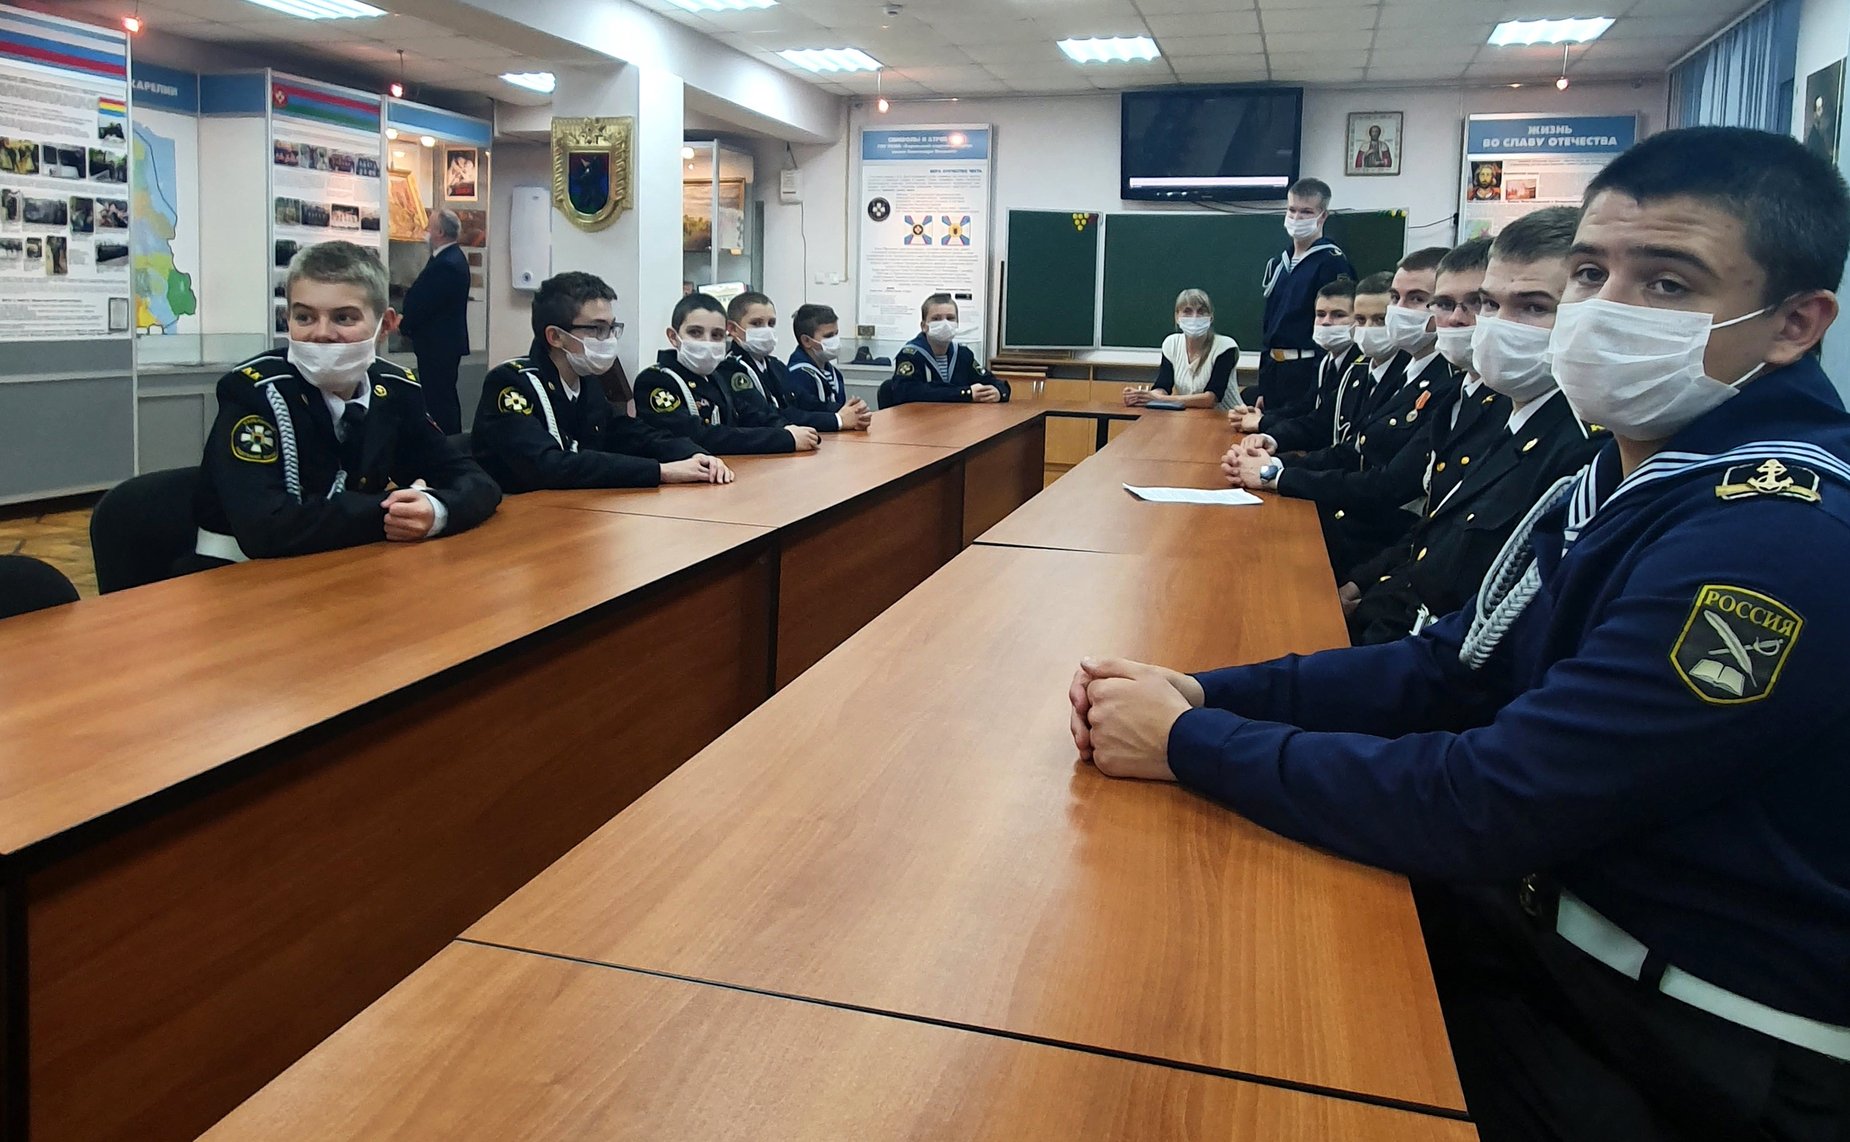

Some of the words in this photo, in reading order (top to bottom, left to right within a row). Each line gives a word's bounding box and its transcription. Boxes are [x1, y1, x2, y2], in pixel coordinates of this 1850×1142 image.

[1528, 125, 1573, 135] ЖИЗНЬ
[1482, 138, 1500, 148] ВО
[1503, 137, 1545, 148] СЛАВУ
[1548, 136, 1618, 147] ОТЕЧЕСТВА
[1704, 590, 1796, 637] РОССИЯ
